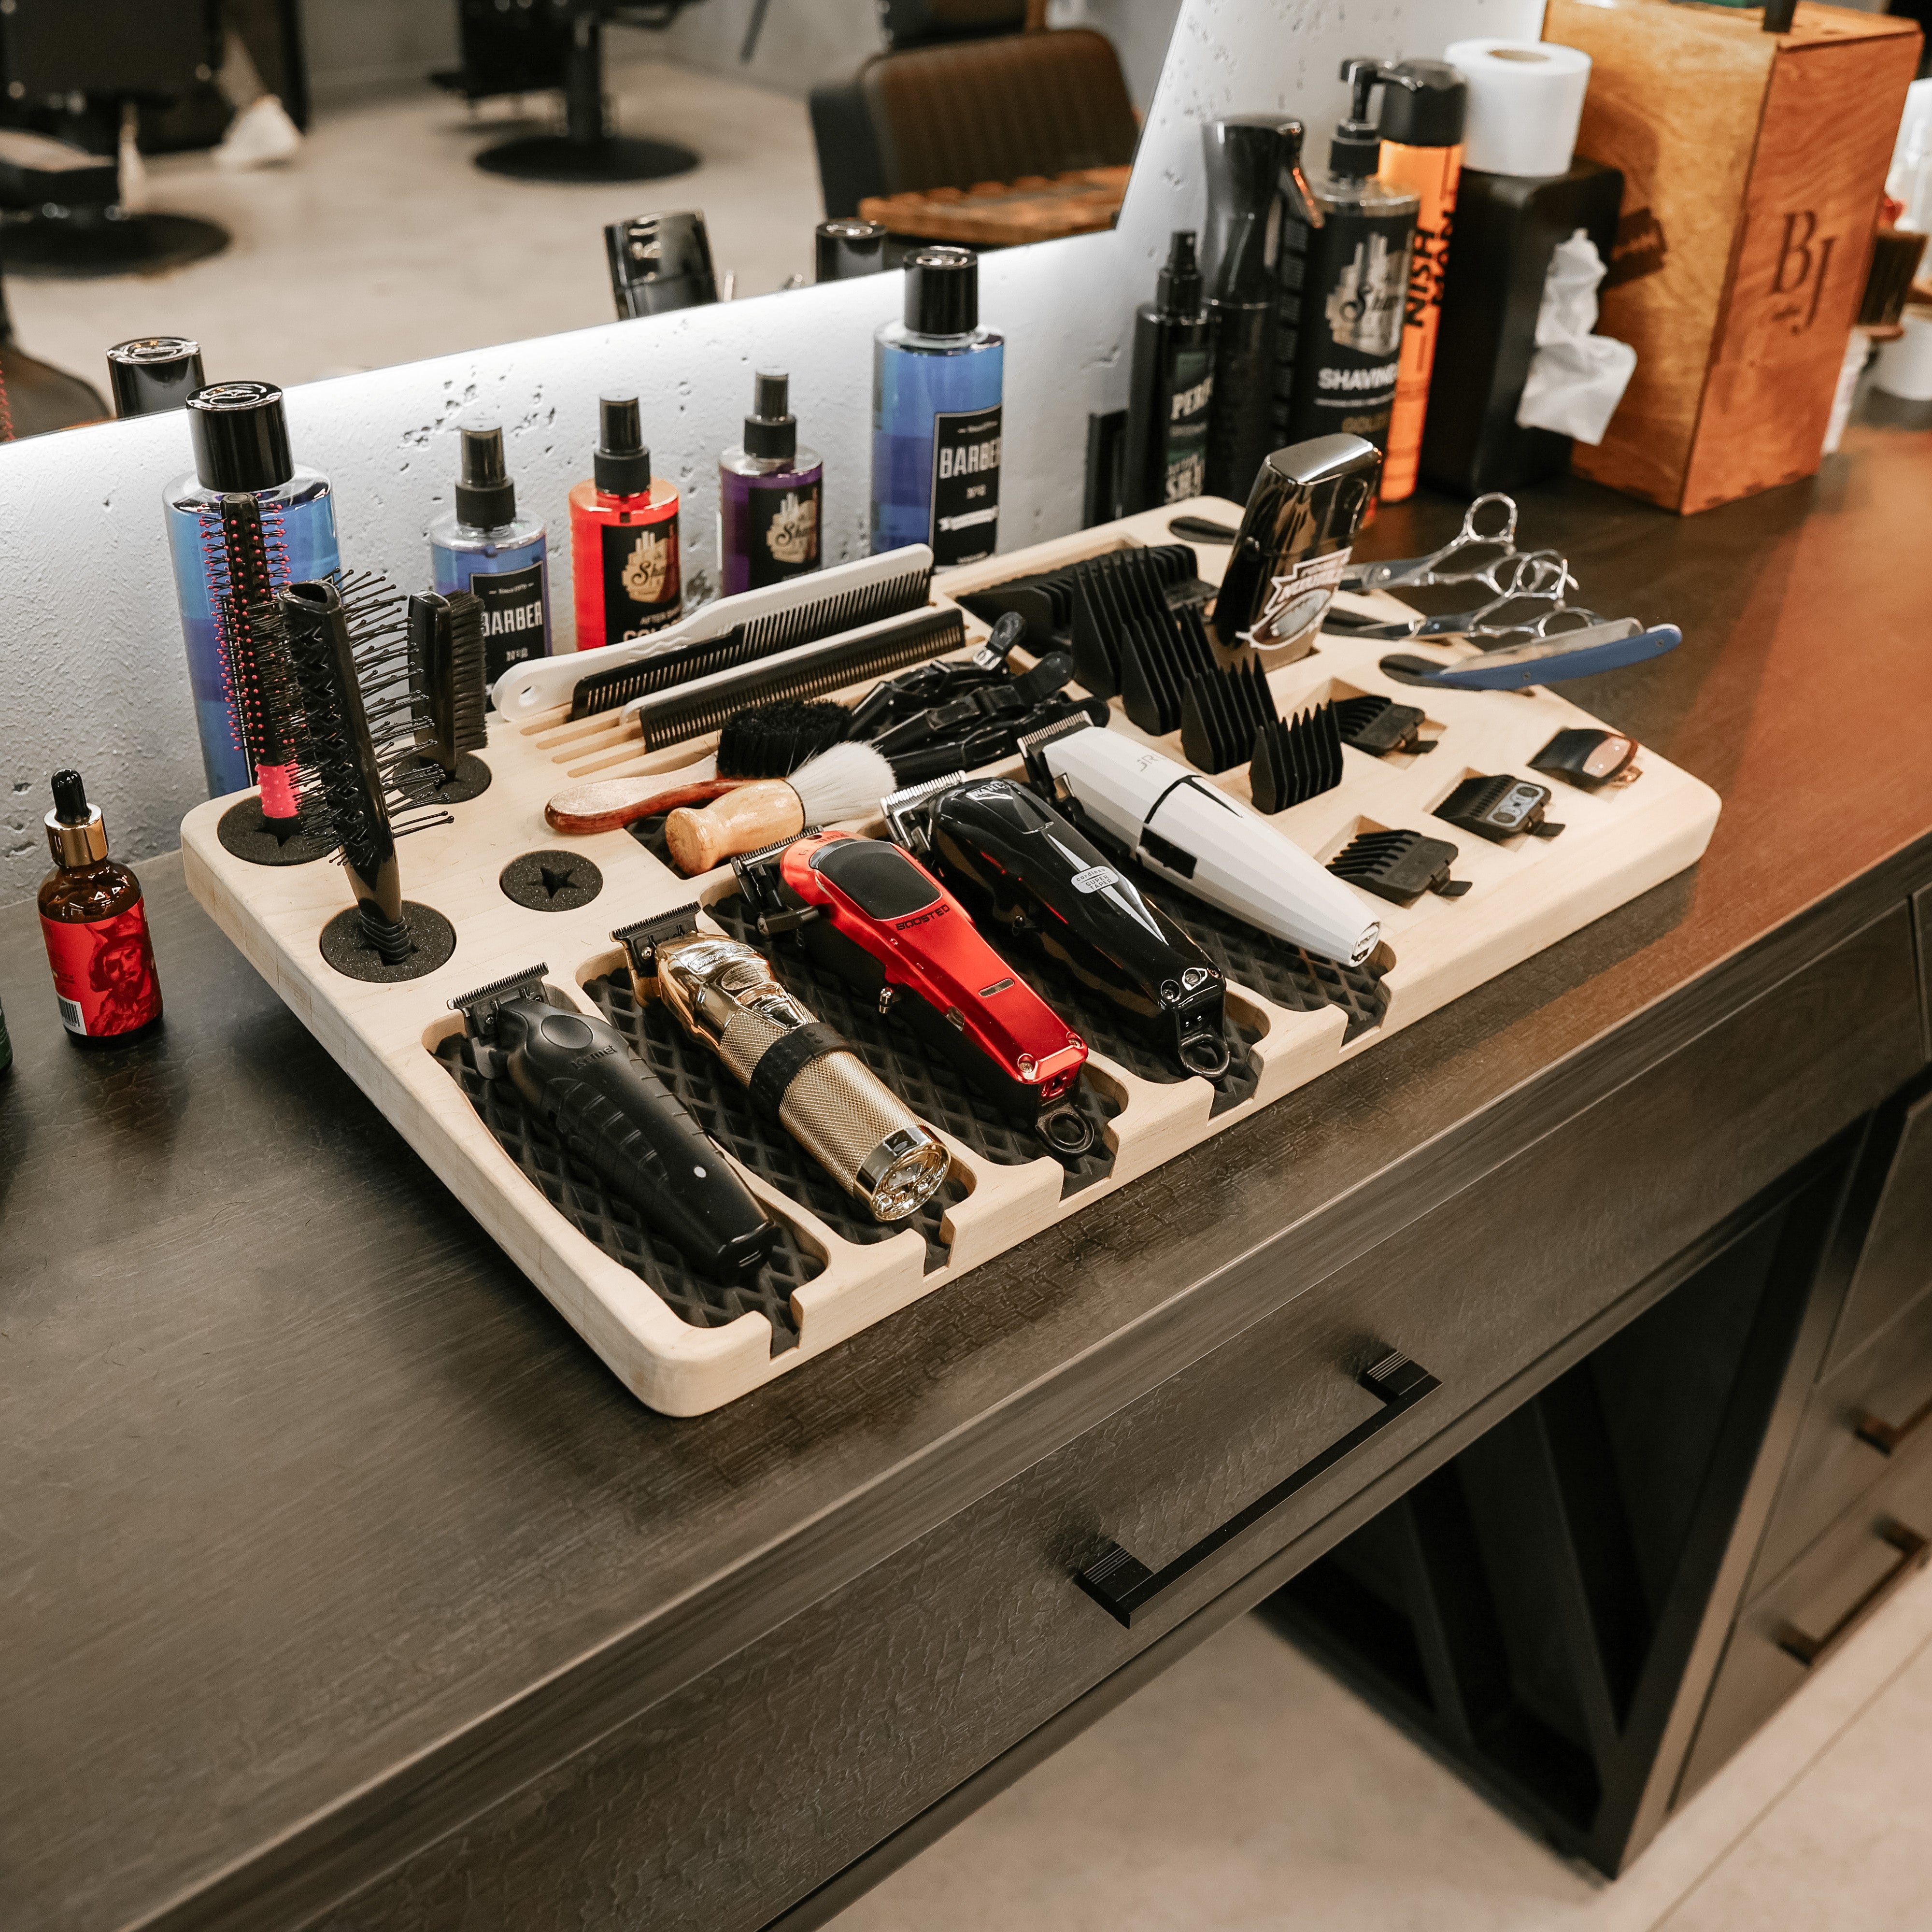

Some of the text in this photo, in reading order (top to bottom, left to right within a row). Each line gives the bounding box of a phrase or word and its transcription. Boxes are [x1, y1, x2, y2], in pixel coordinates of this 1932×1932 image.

[1768, 210, 1837, 334] BJ
[939, 437, 1001, 479] BARBE
[1076, 868, 1106, 881] cordless
[1085, 875, 1109, 887] SUPER
[1089, 880, 1113, 890] TAPER
[895, 904, 951, 926] BOOSTED
